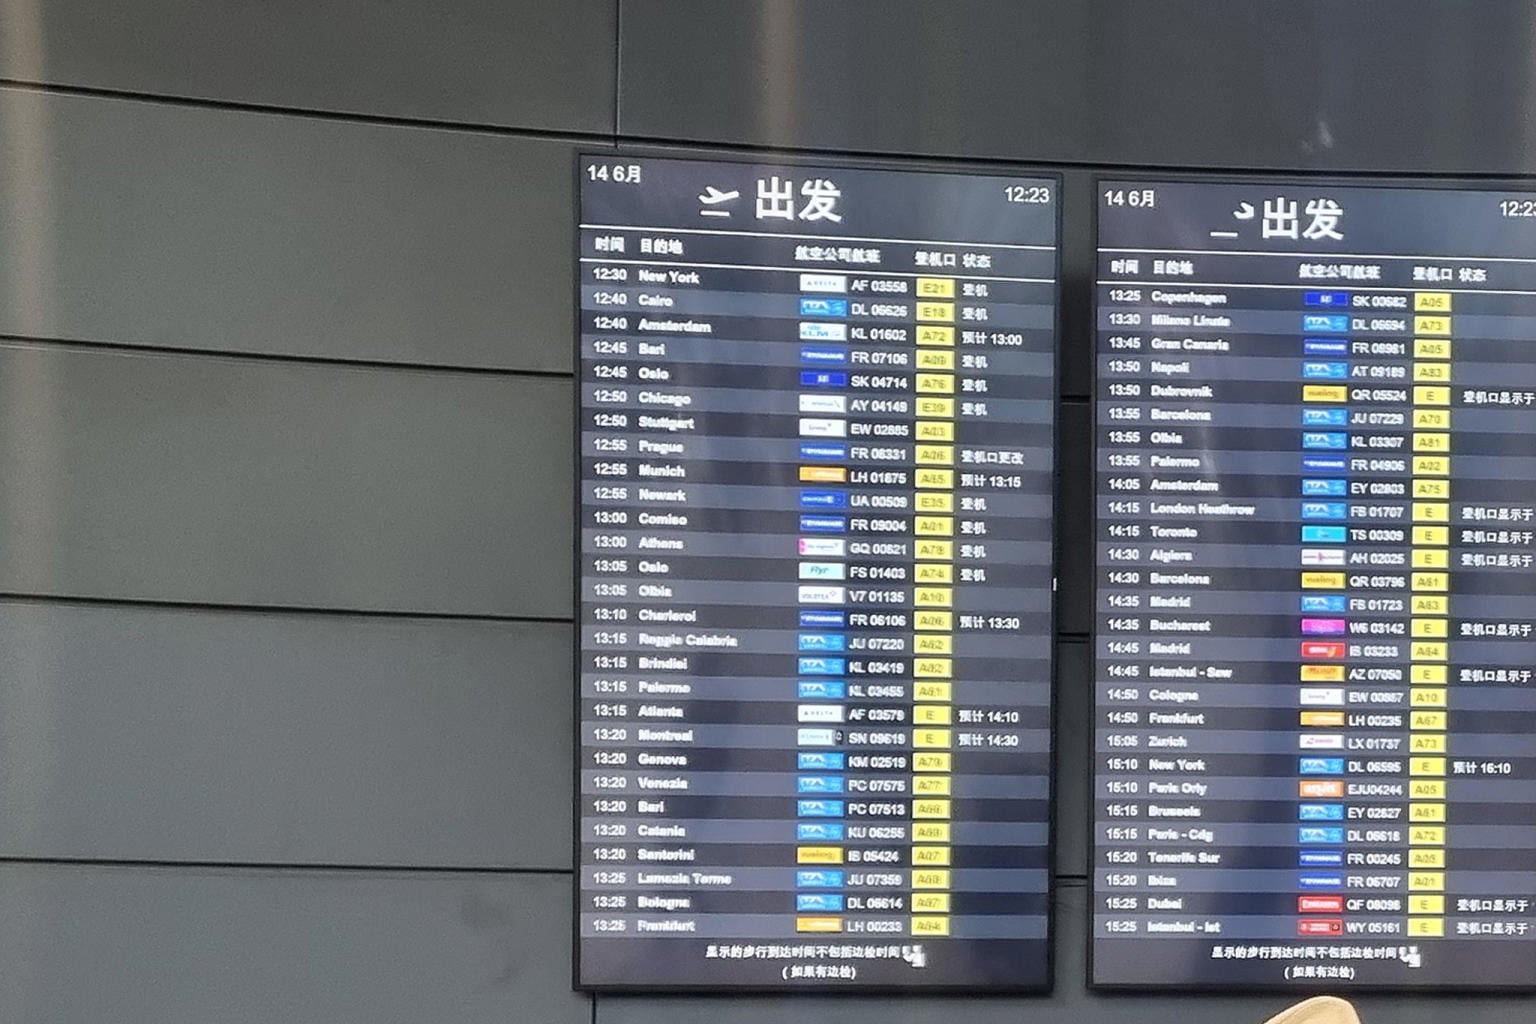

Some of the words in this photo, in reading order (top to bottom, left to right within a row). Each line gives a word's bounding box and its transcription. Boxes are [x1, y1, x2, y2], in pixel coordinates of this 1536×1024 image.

[588, 165, 608, 180] 14
[613, 166, 640, 183] 6月
[756, 177, 841, 222] 出发
[1005, 187, 1049, 203] 12:23
[1105, 191, 1124, 205] 14
[1129, 191, 1154, 207] 6月
[1263, 198, 1343, 240] 出发
[595, 236, 624, 252] 时间
[641, 239, 683, 254] 目的地
[963, 254, 991, 268] 状态
[594, 268, 627, 280] 12:30
[1112, 260, 1138, 273] 时间
[1154, 261, 1193, 274] 目的地
[1459, 268, 1486, 281] 状态
[594, 317, 627, 329] 12:40
[852, 328, 871, 339] KL
[870, 329, 906, 340] 01602
[991, 334, 1022, 345] 13:00
[594, 366, 627, 378] 12:45
[851, 376, 869, 387] SK
[594, 390, 627, 402] 12:50
[1109, 385, 1140, 395] 13:50
[594, 463, 627, 475] 12:55
[990, 476, 1021, 487] 13:15
[1109, 502, 1140, 513] 14:15
[595, 536, 627, 547] 13:00
[1109, 573, 1139, 583] 14:30
[595, 609, 627, 619] 13:10
[988, 618, 1019, 629] 13:30
[594, 705, 626, 716] 13:15
[988, 712, 1018, 722] 14:10
[1108, 712, 1138, 723] 14:50
[1349, 715, 1369, 726] LH
[1108, 759, 1138, 769] 15:10
[1481, 763, 1511, 773] 16:10
